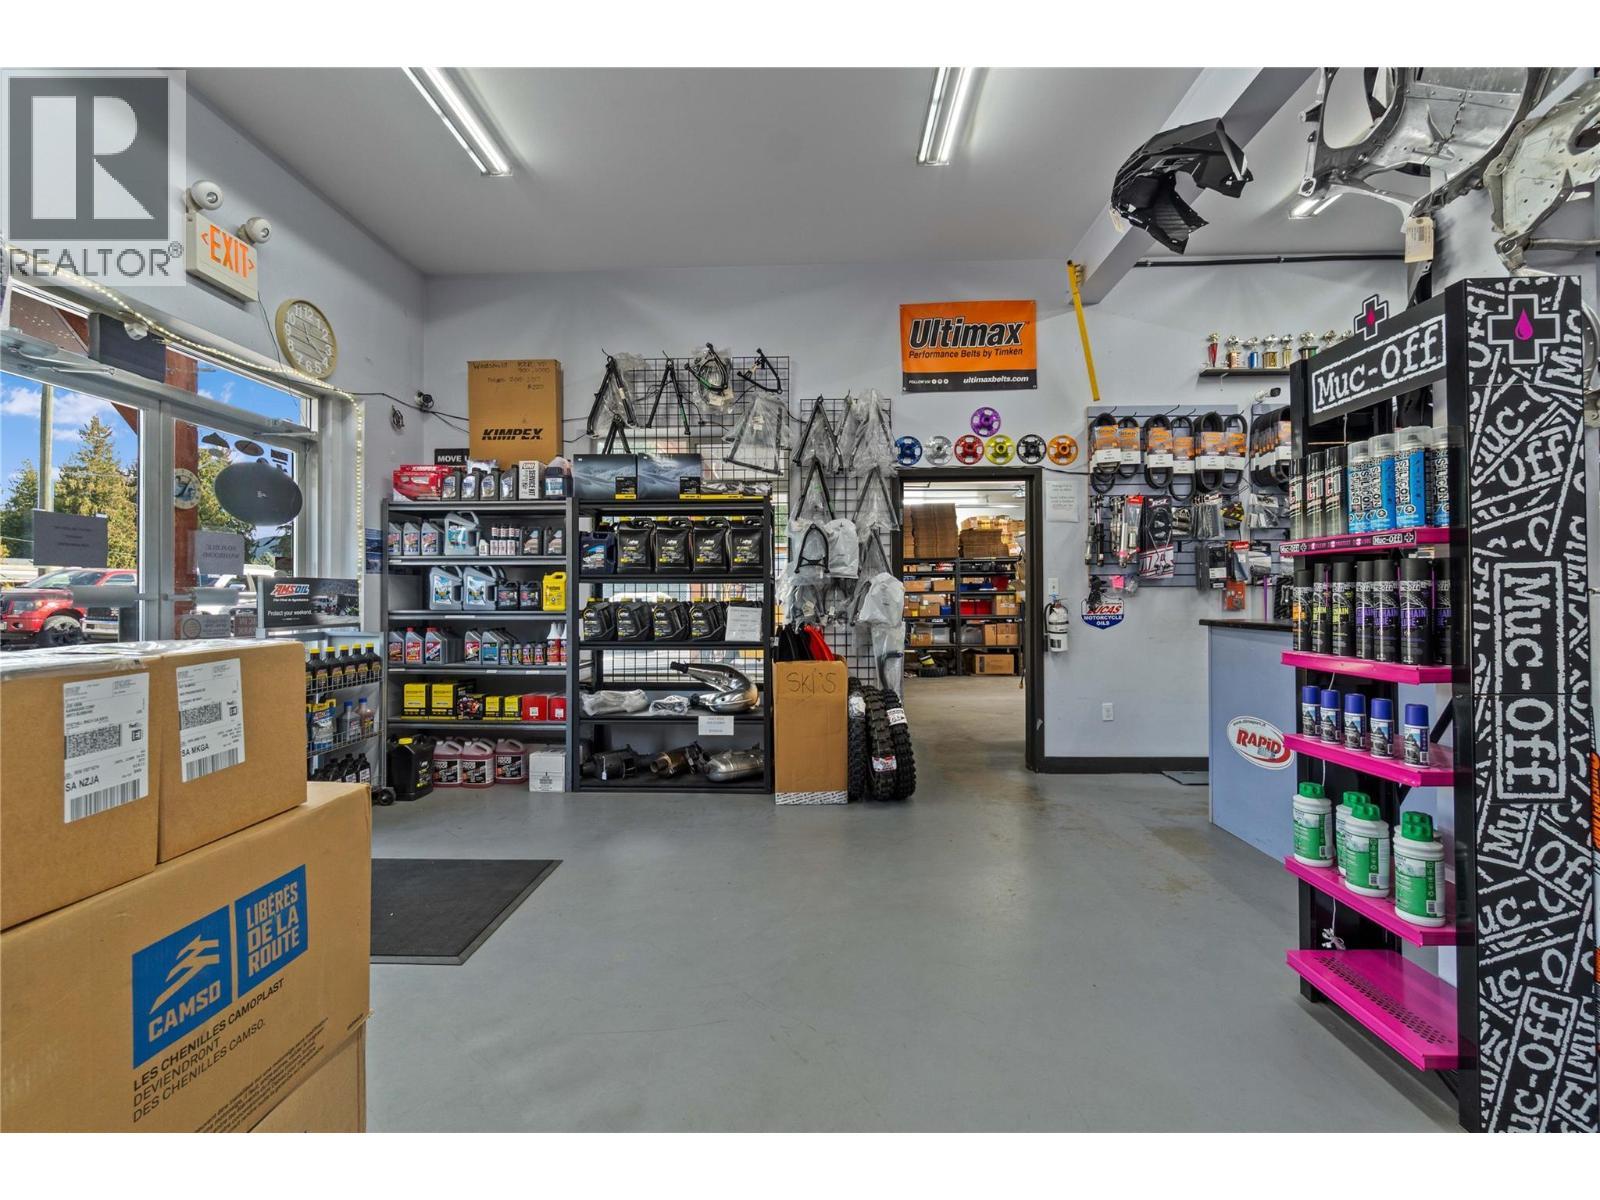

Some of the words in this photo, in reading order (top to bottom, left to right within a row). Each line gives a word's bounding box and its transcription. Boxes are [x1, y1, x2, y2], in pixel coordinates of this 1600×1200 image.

[209, 224, 249, 278] EXIT
[909, 317, 1024, 348] Ultimax
[909, 350, 958, 359] Performance
[961, 349, 980, 358] Belts
[983, 349, 992, 359] by
[995, 347, 1023, 356] Timken
[963, 376, 1029, 384] ultimaxbelts.com
[1317, 324, 1439, 405] Muc-Off
[482, 428, 543, 441] KIMPEX
[272, 584, 309, 597] AMSOIL
[1504, 573, 1557, 788] Muc-Off
[65, 781, 77, 792] SA
[79, 775, 100, 788] NZJA
[246, 881, 298, 930] LIBÉRÉS
[247, 918, 272, 953] DE
[275, 905, 299, 933] LA
[248, 926, 300, 977] ROUTE
[133, 1069, 159, 1092] LES
[161, 1021, 226, 1069] CHENILLES
[228, 977, 285, 1025] CAMOPLAST
[148, 980, 222, 1042] CAMSO
[132, 1037, 221, 1107] DEVIENDRONT
[133, 1098, 160, 1123] DES
[162, 1049, 228, 1100] CHENILLES
[228, 1018, 266, 1055] CAMSO.
